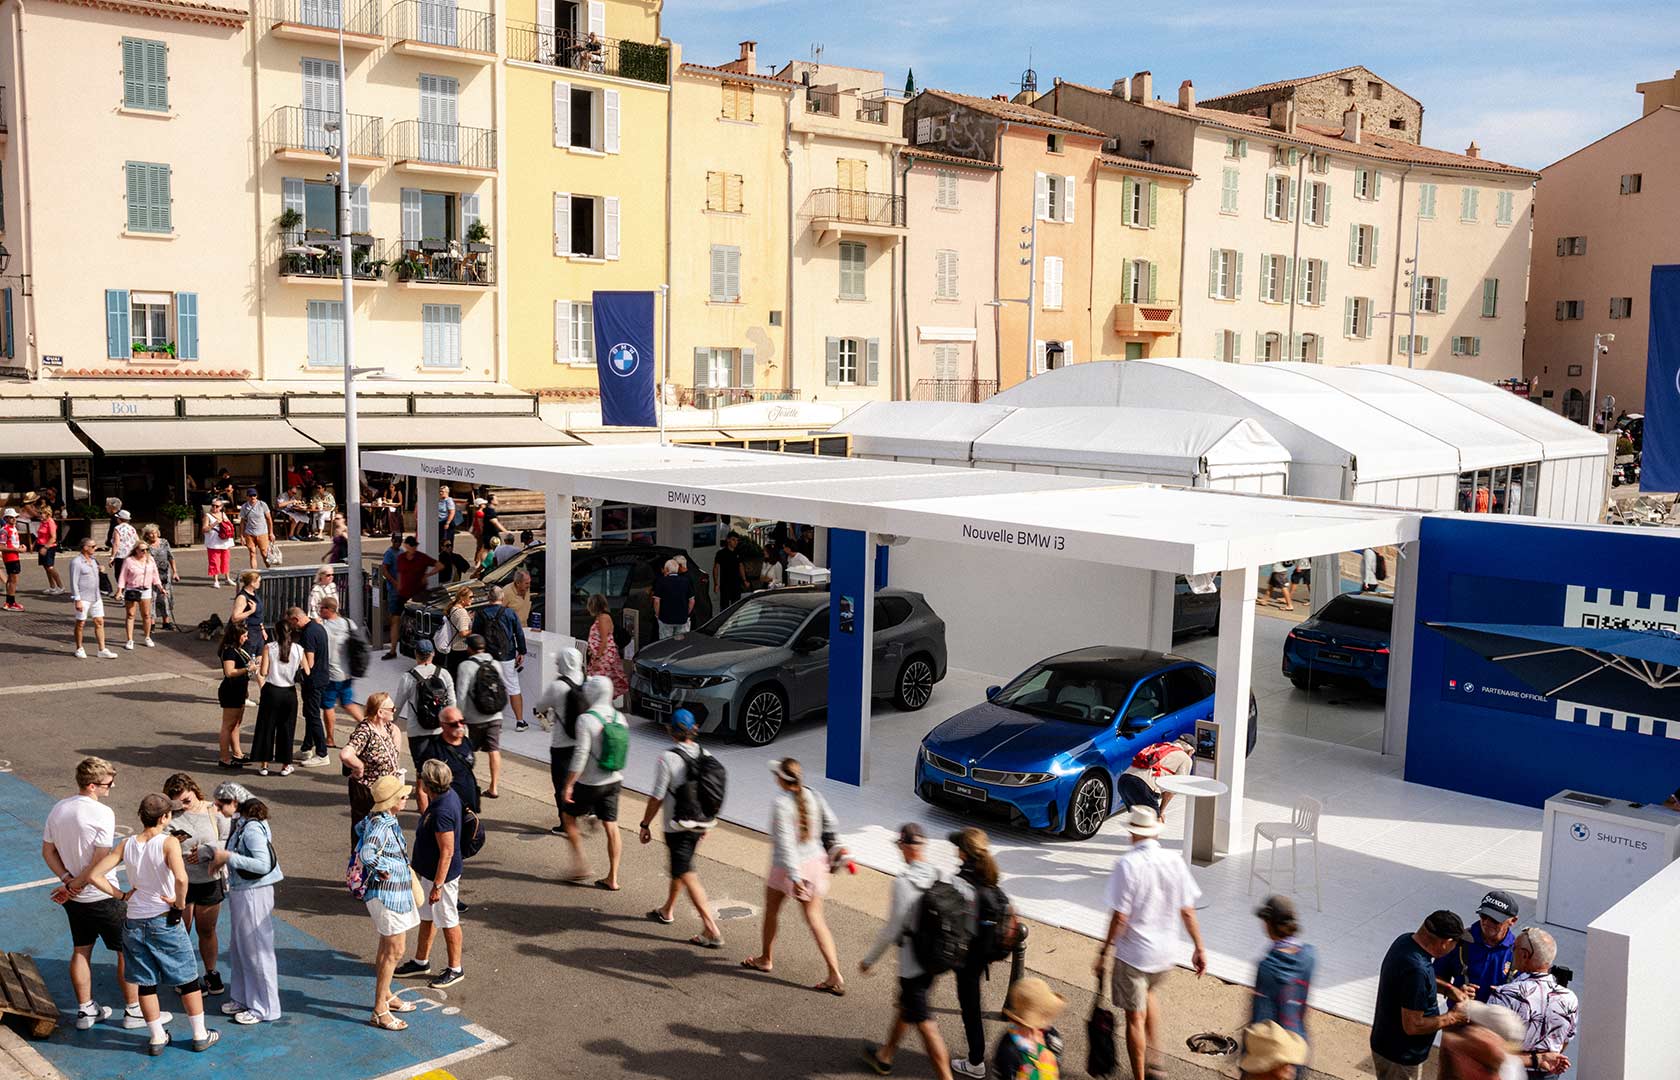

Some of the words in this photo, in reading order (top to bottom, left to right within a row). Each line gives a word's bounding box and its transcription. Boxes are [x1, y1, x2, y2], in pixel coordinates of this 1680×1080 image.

[420, 463, 446, 475] Nouvelle
[446, 466, 464, 477] BMW
[668, 490, 691, 504] BMW
[691, 493, 706, 506] iX3
[962, 524, 1014, 544] Nouvelle
[1017, 531, 1051, 549] BMW
[1054, 536, 1065, 550] i3
[1481, 686, 1519, 698] PARTENAIRE
[1597, 832, 1648, 850] SHUTTLES
